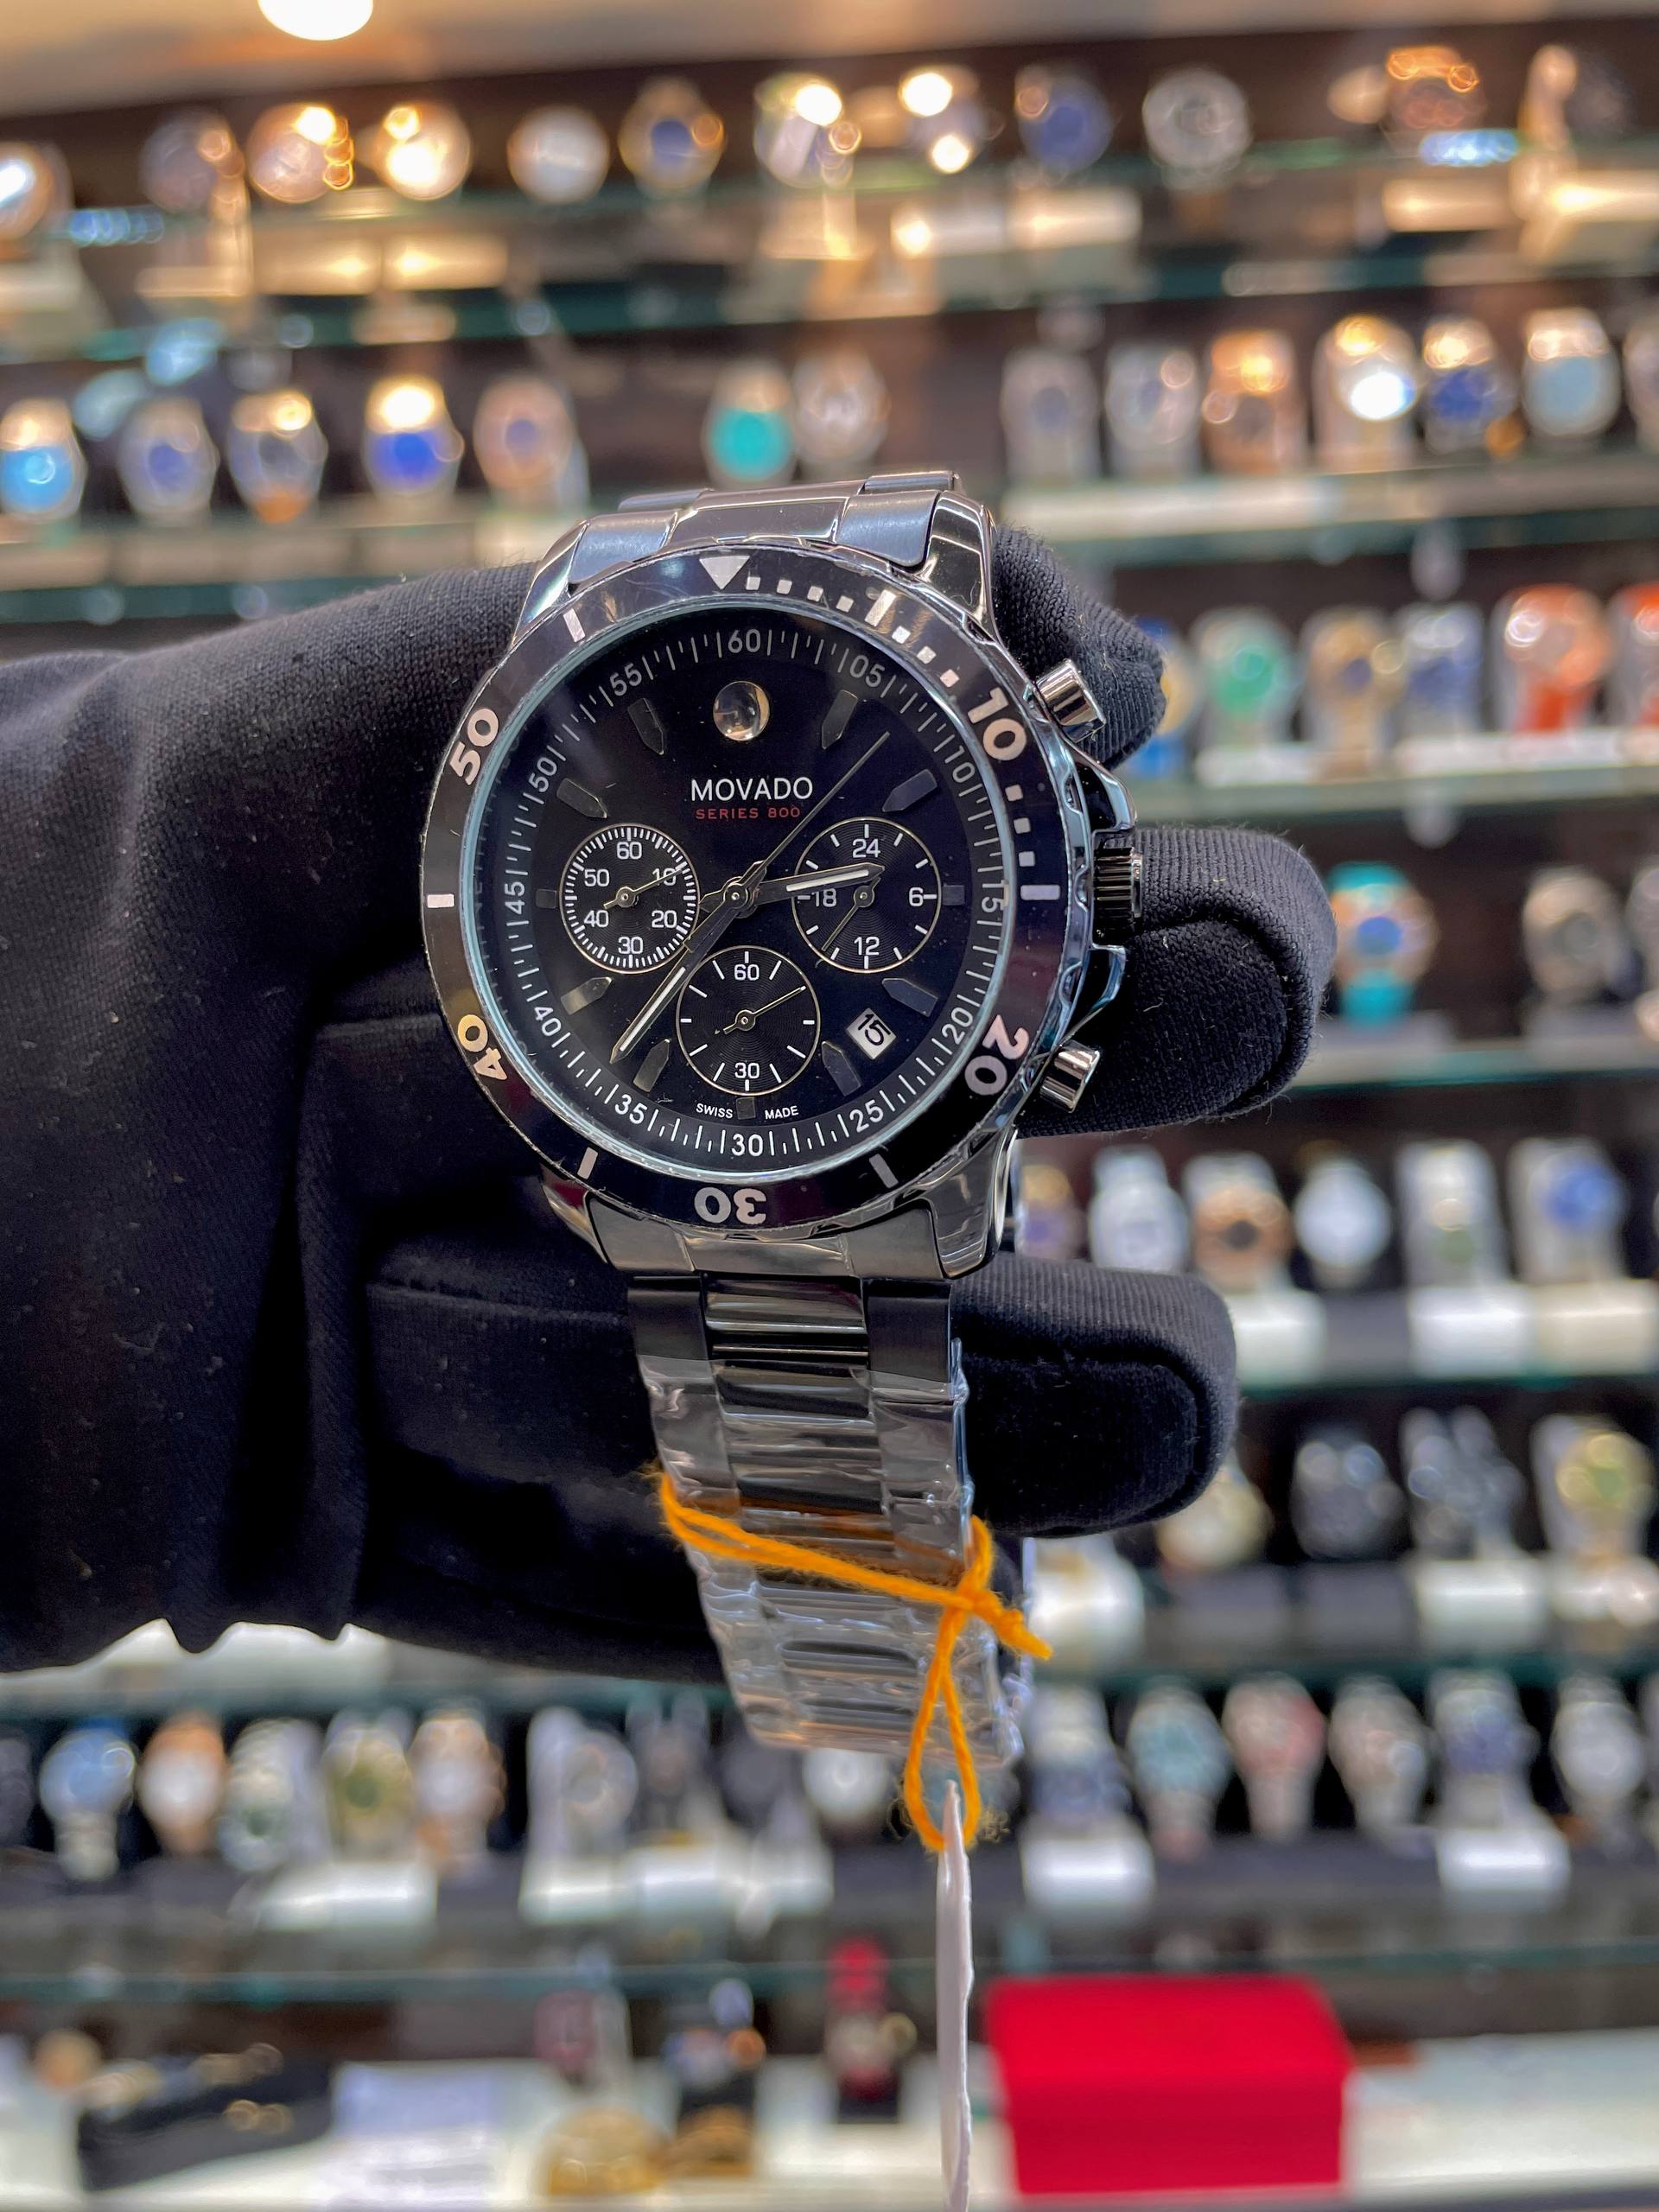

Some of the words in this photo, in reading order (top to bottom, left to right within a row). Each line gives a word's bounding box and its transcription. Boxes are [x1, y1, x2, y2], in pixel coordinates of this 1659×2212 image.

[728, 628, 761, 653] 60
[610, 662, 643, 697] 55
[849, 654, 886, 689] 05
[967, 686, 1028, 761] 10
[448, 708, 499, 786] 50
[529, 756, 558, 792] 50
[948, 744, 976, 784] 10
[690, 778, 813, 802] MOVADO
[695, 807, 759, 819] SERIES
[767, 806, 800, 818] 800
[616, 842, 644, 860] 60
[852, 838, 880, 859] 24
[583, 868, 610, 886] 50
[652, 868, 677, 886] 10
[503, 881, 526, 916] 45
[908, 887, 924, 906] 6
[981, 880, 1009, 913] 15
[583, 910, 609, 928] 40
[651, 910, 677, 928] 20
[617, 936, 644, 954] 30
[854, 937, 880, 956] 12
[734, 963, 760, 982] 60
[533, 1005, 562, 1037] 40
[857, 1014, 892, 1046] 15
[941, 1006, 974, 1043] 20
[457, 1014, 509, 1081] 40
[964, 1014, 1030, 1096] 20
[734, 1062, 760, 1080] 30
[614, 1093, 648, 1125] 35
[696, 1103, 734, 1119] SWISS
[765, 1105, 799, 1121] MADE
[849, 1099, 884, 1133] 25
[731, 1133, 764, 1157] 30
[693, 1186, 767, 1225] 30
